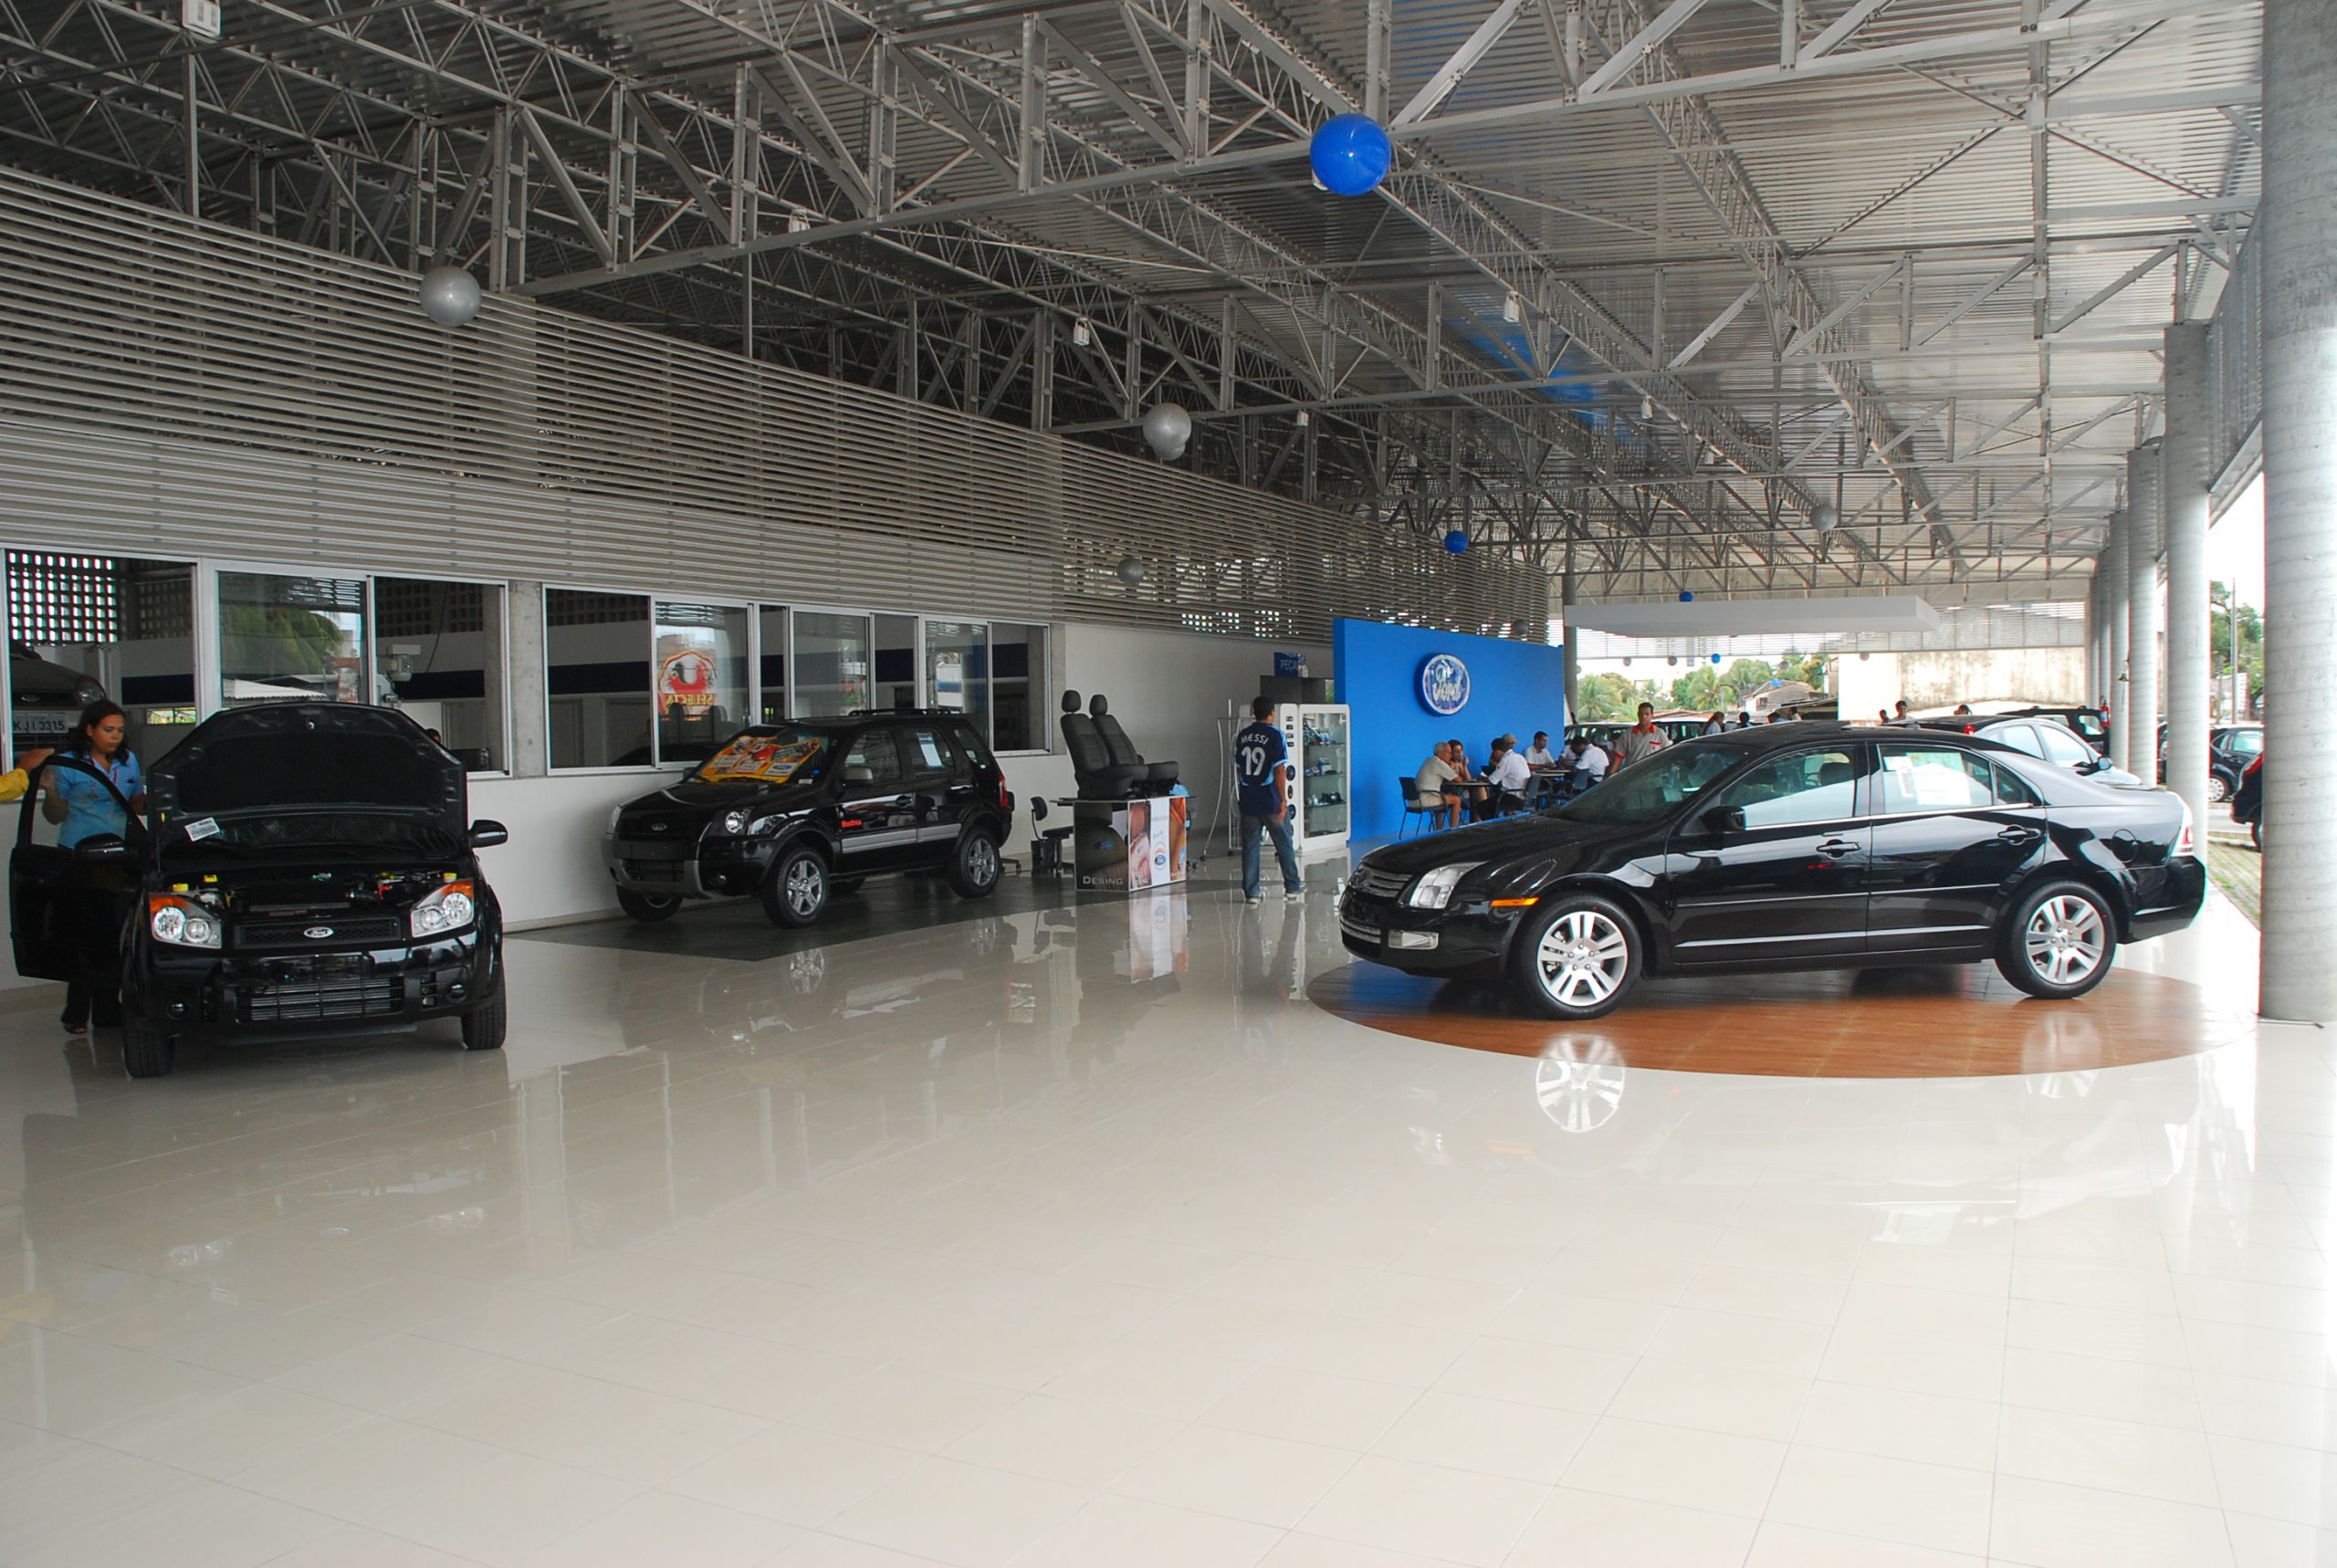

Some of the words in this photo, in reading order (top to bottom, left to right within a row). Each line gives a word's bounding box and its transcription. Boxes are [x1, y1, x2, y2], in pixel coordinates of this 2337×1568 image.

[1432, 660, 1462, 702] Ford
[1241, 733, 1269, 745] MESSI
[1241, 746, 1266, 776] 19
